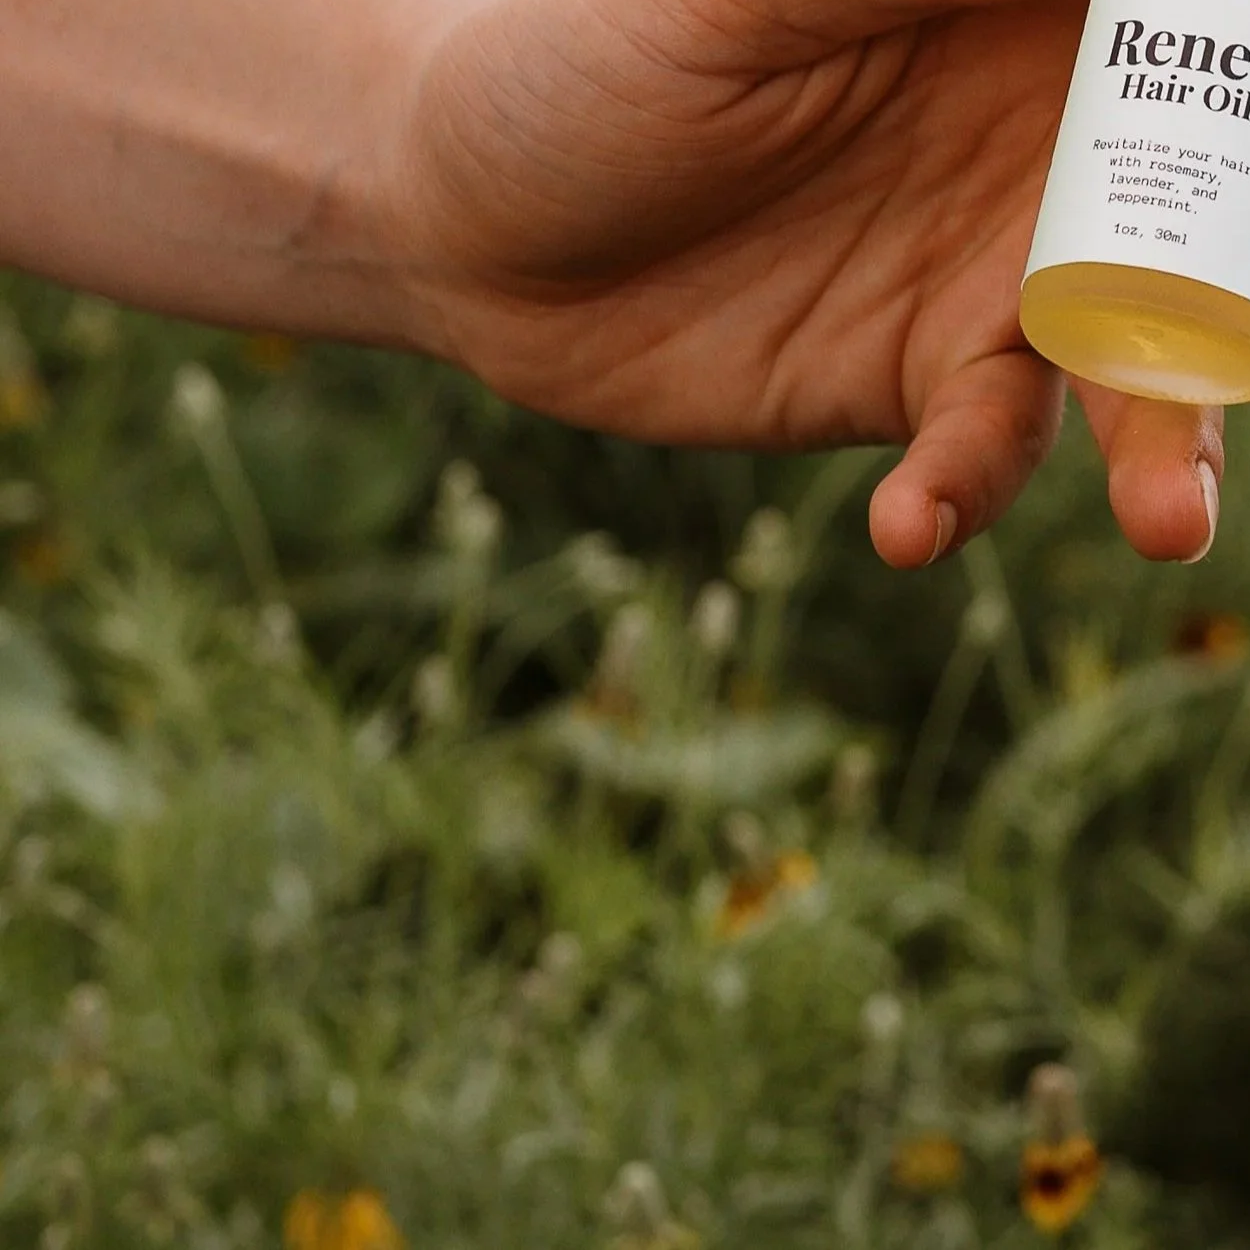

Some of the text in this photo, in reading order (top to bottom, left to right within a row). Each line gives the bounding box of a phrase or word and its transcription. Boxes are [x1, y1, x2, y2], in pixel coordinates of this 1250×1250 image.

[1119, 73, 1195, 104] Hair
[1093, 137, 1171, 154] Revitalize
[1178, 148, 1213, 163] your
[1110, 155, 1222, 186] with rosemary,
[1110, 173, 1218, 201] lavender, and
[1108, 192, 1199, 214] peppermint.
[1114, 223, 1188, 246] 1oz, 30ml
